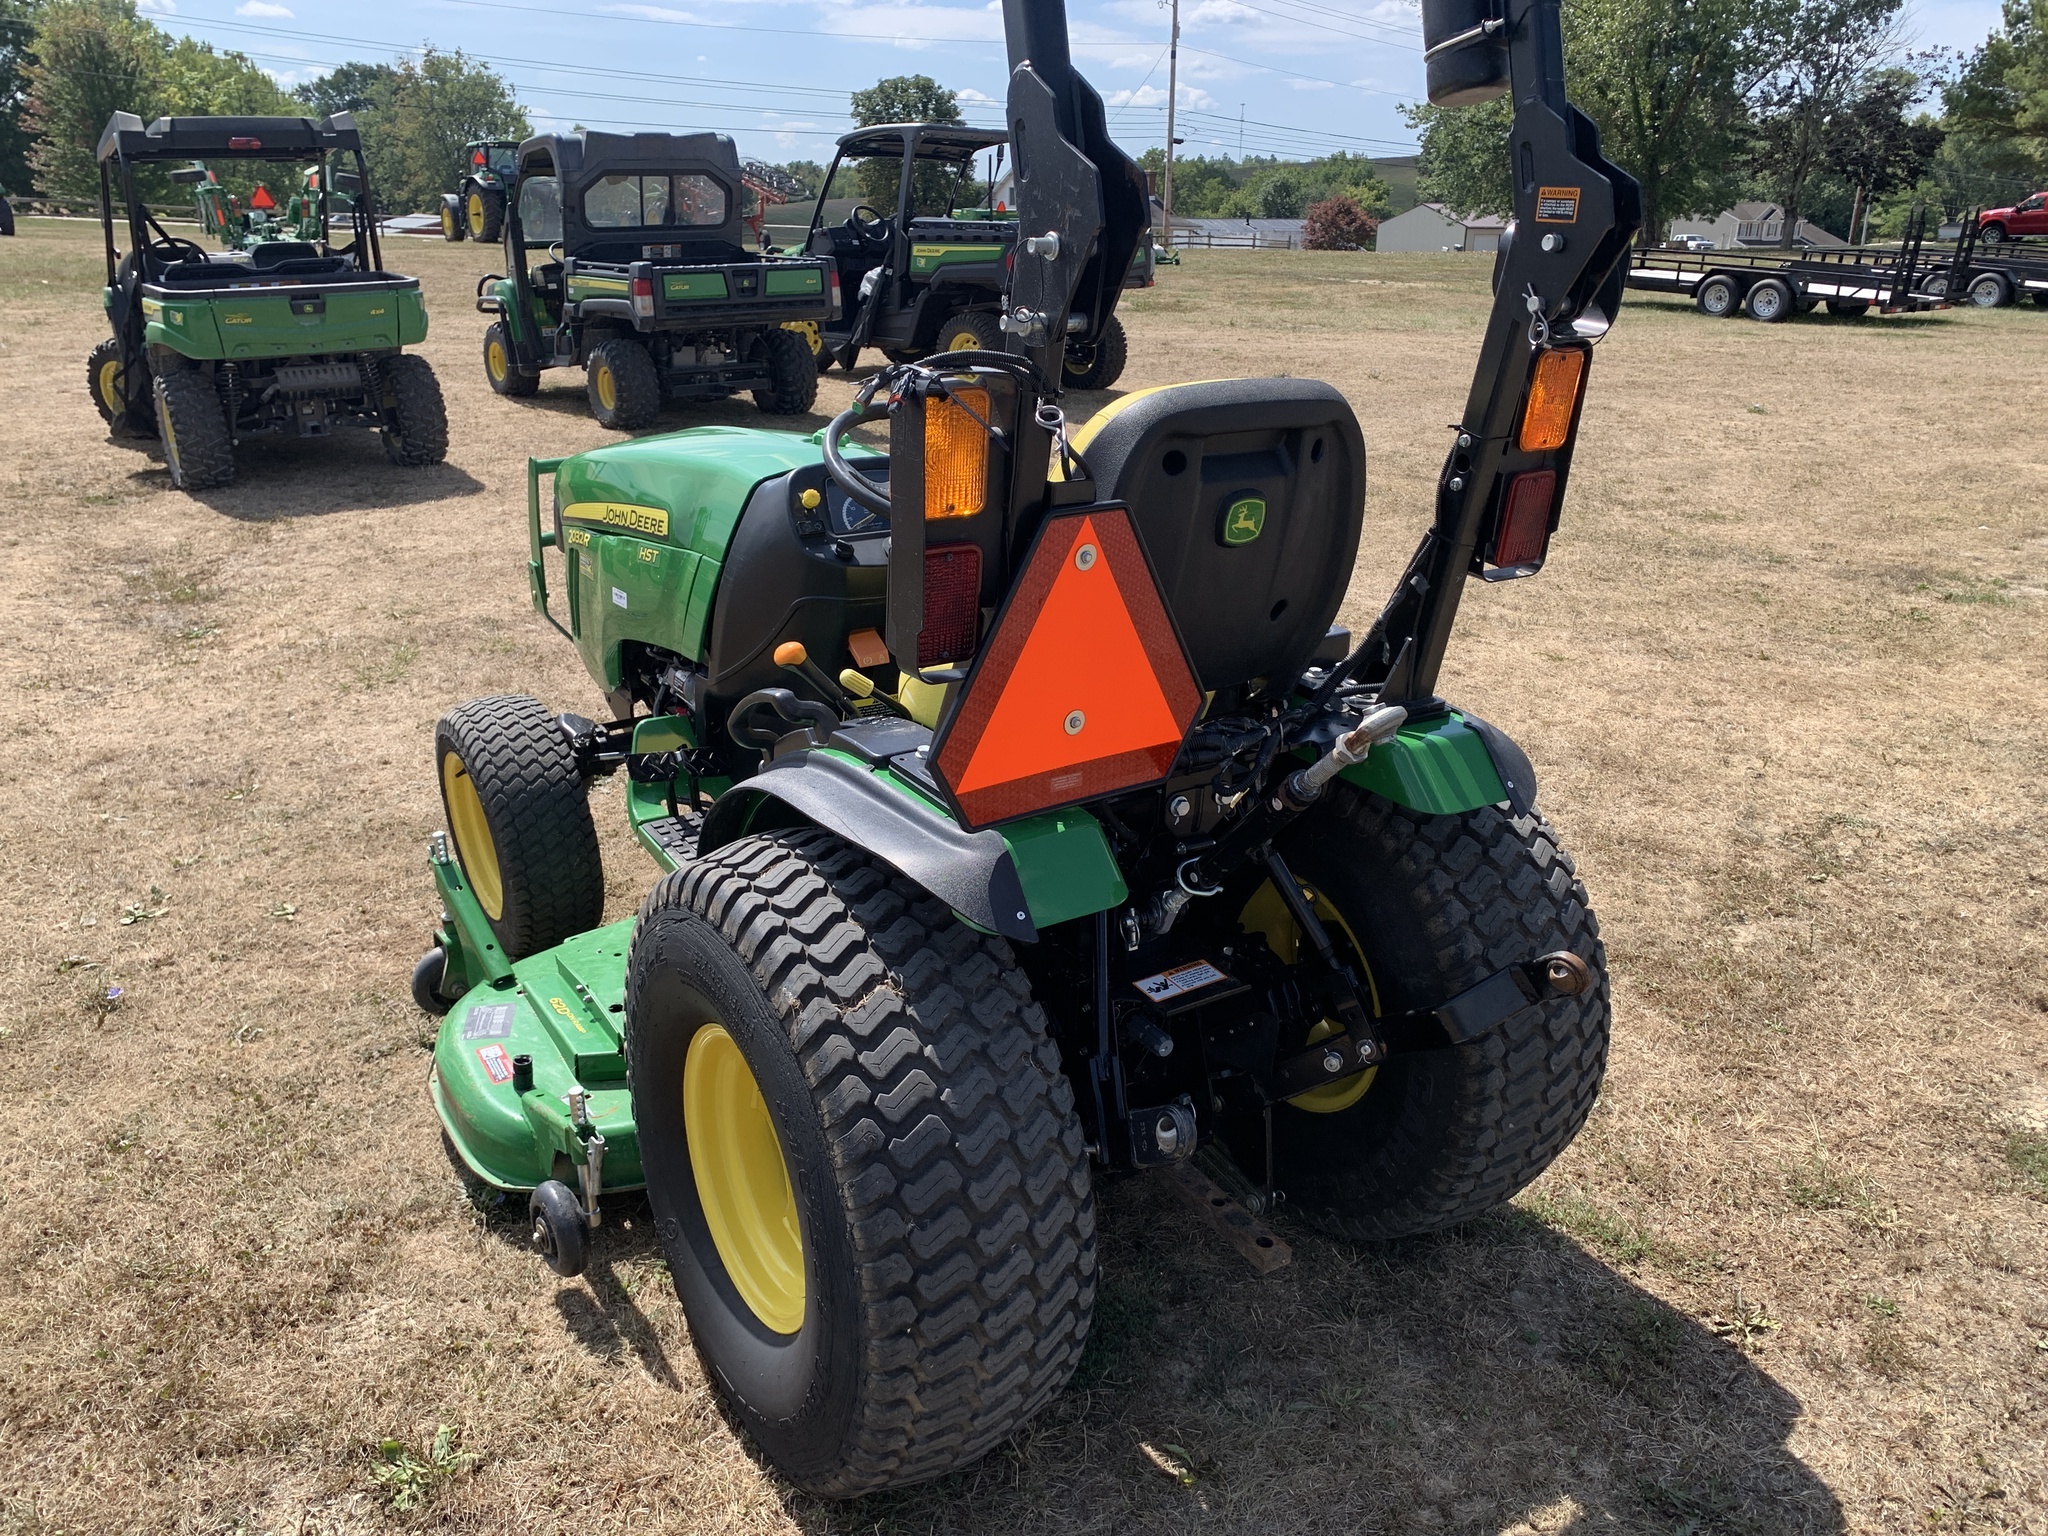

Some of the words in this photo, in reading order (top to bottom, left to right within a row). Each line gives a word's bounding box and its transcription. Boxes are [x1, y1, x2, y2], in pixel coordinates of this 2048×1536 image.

[1547, 189, 1578, 197] WARNING
[603, 505, 629, 524] JOHN
[629, 510, 665, 533] DEERE
[568, 529, 591, 547] 2032R
[638, 546, 660, 563] HST
[549, 997, 571, 1015] 62D
